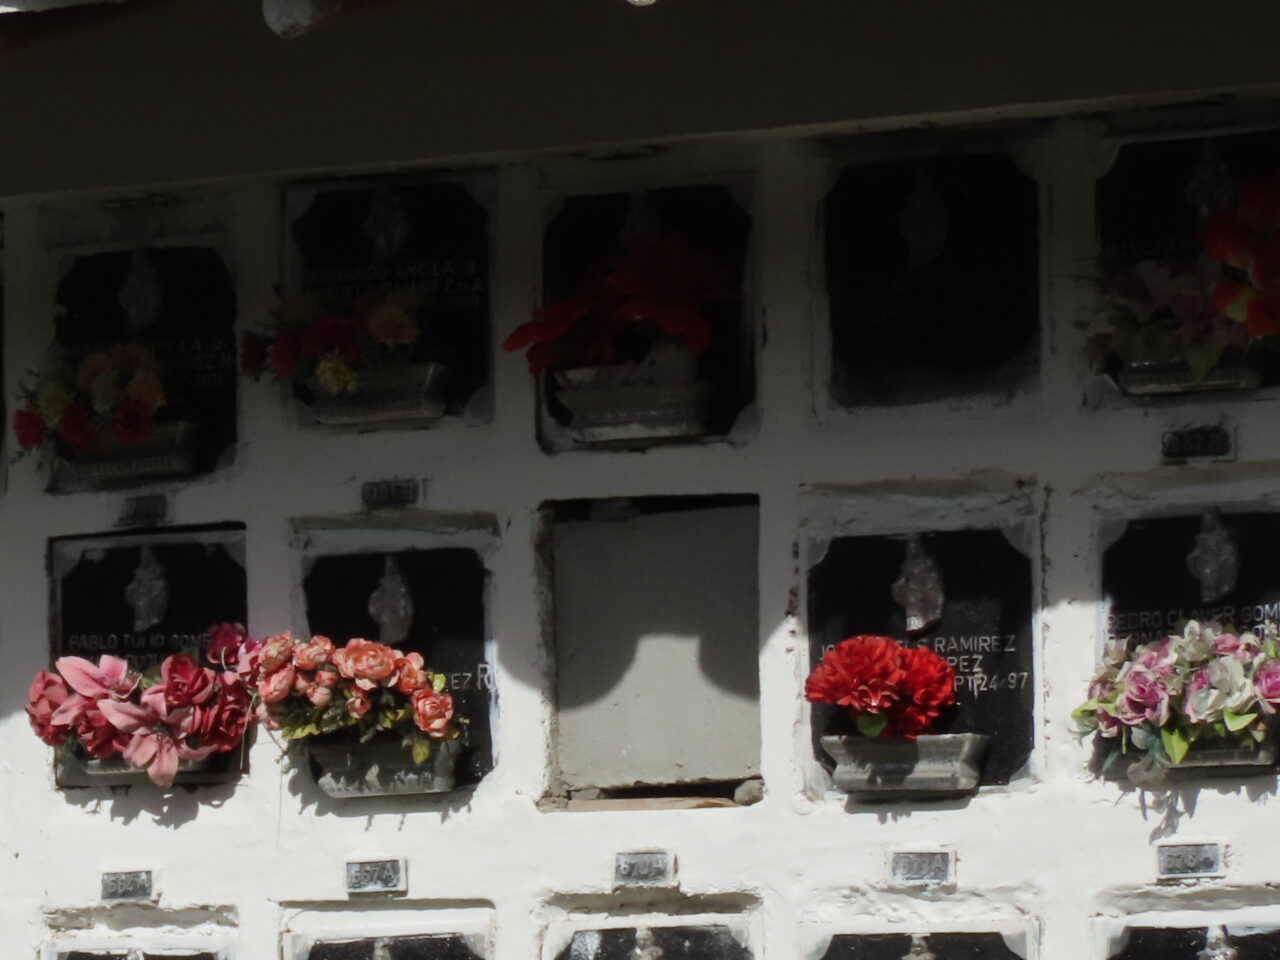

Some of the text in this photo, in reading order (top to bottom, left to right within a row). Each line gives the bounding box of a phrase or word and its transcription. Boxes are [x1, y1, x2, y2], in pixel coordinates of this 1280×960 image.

[69, 632, 118, 651] PABLO
[170, 632, 213, 650] GOME
[934, 635, 1017, 653] RAMIREZ
